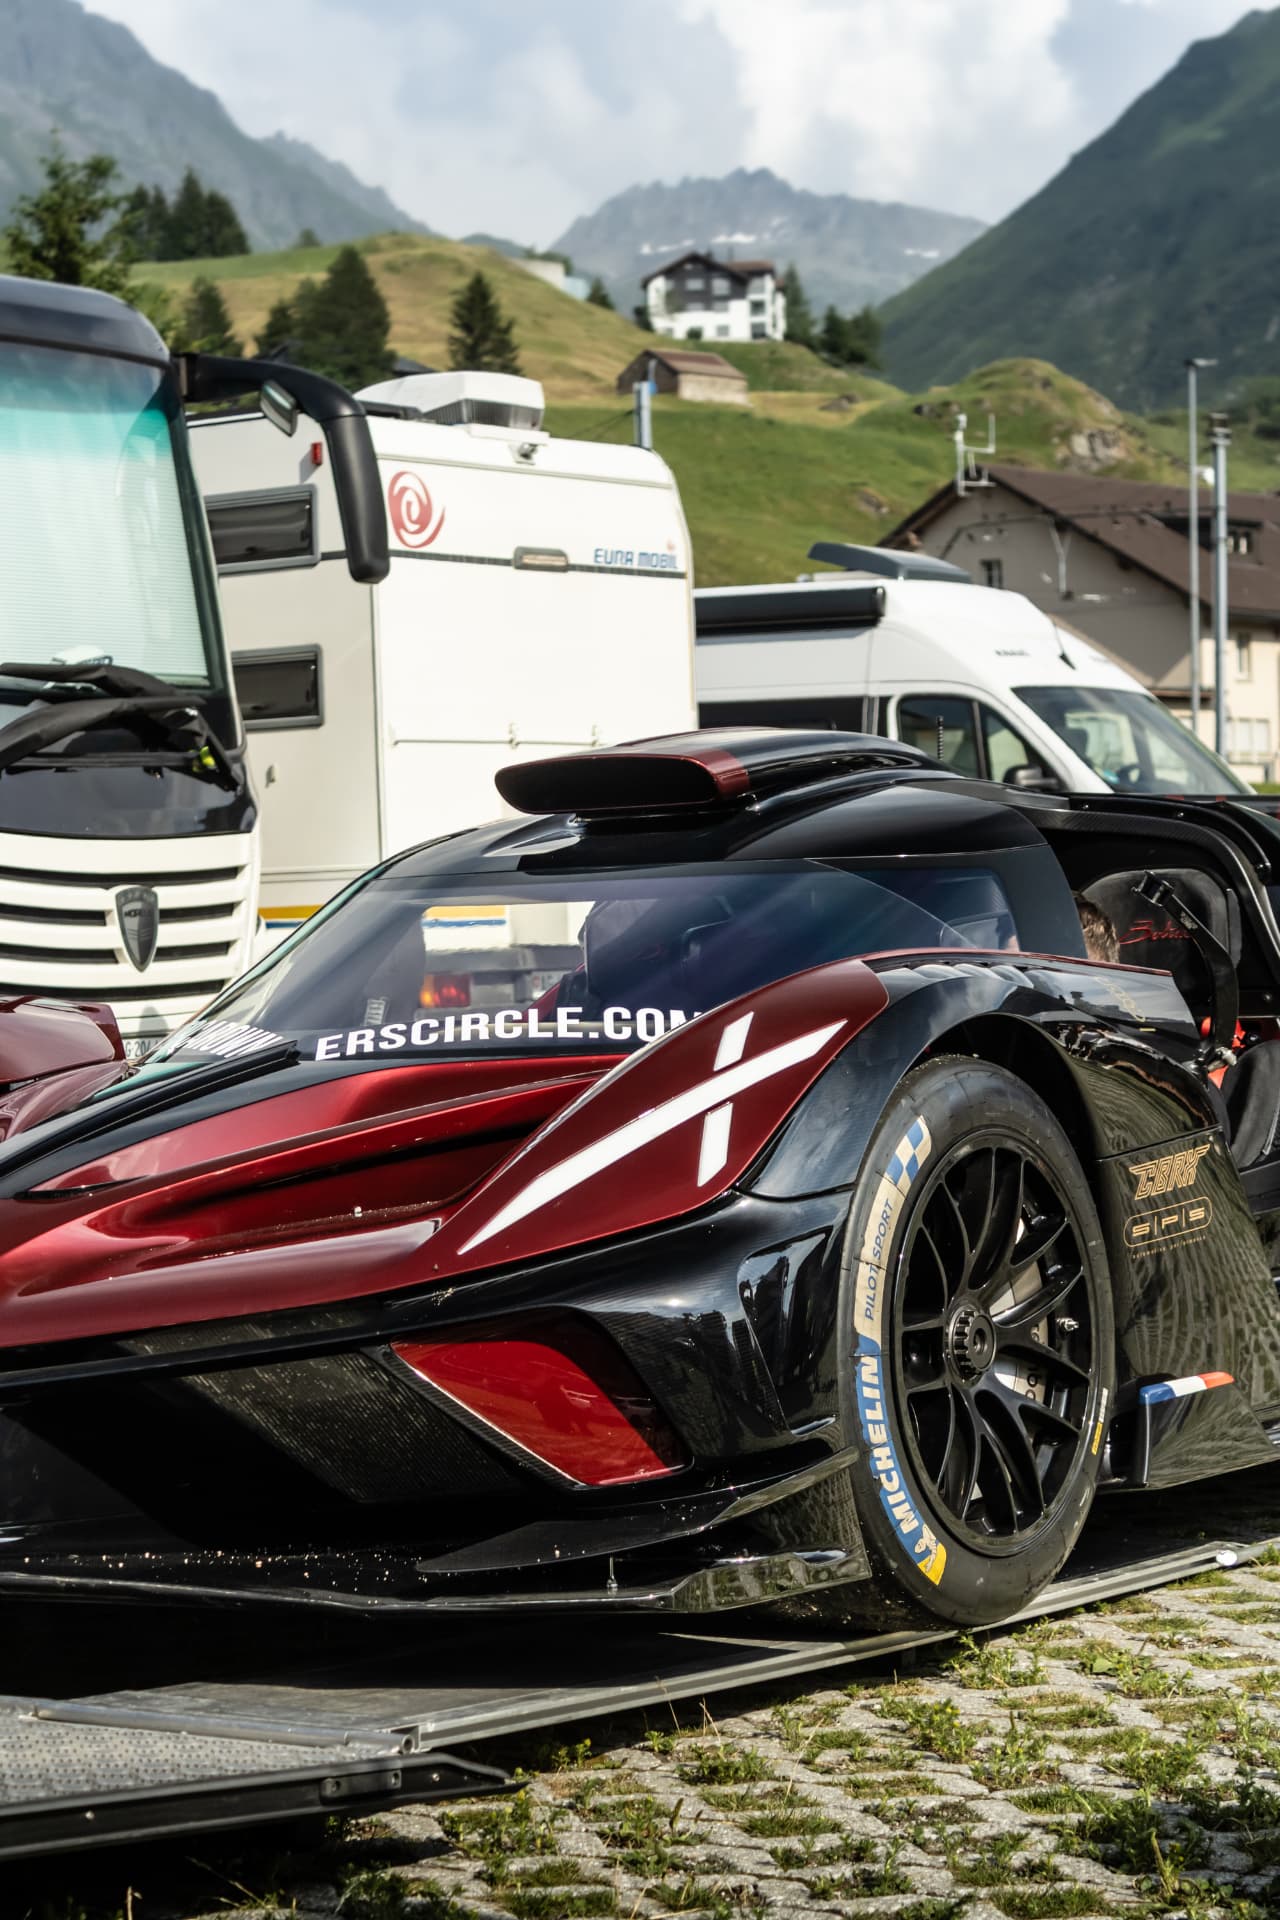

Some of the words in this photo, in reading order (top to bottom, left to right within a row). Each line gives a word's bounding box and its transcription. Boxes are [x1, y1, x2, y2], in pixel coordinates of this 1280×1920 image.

[864, 1262, 880, 1321] PILOT
[872, 1198, 894, 1261] SPORT
[860, 1353, 919, 1535] MICHELIN
